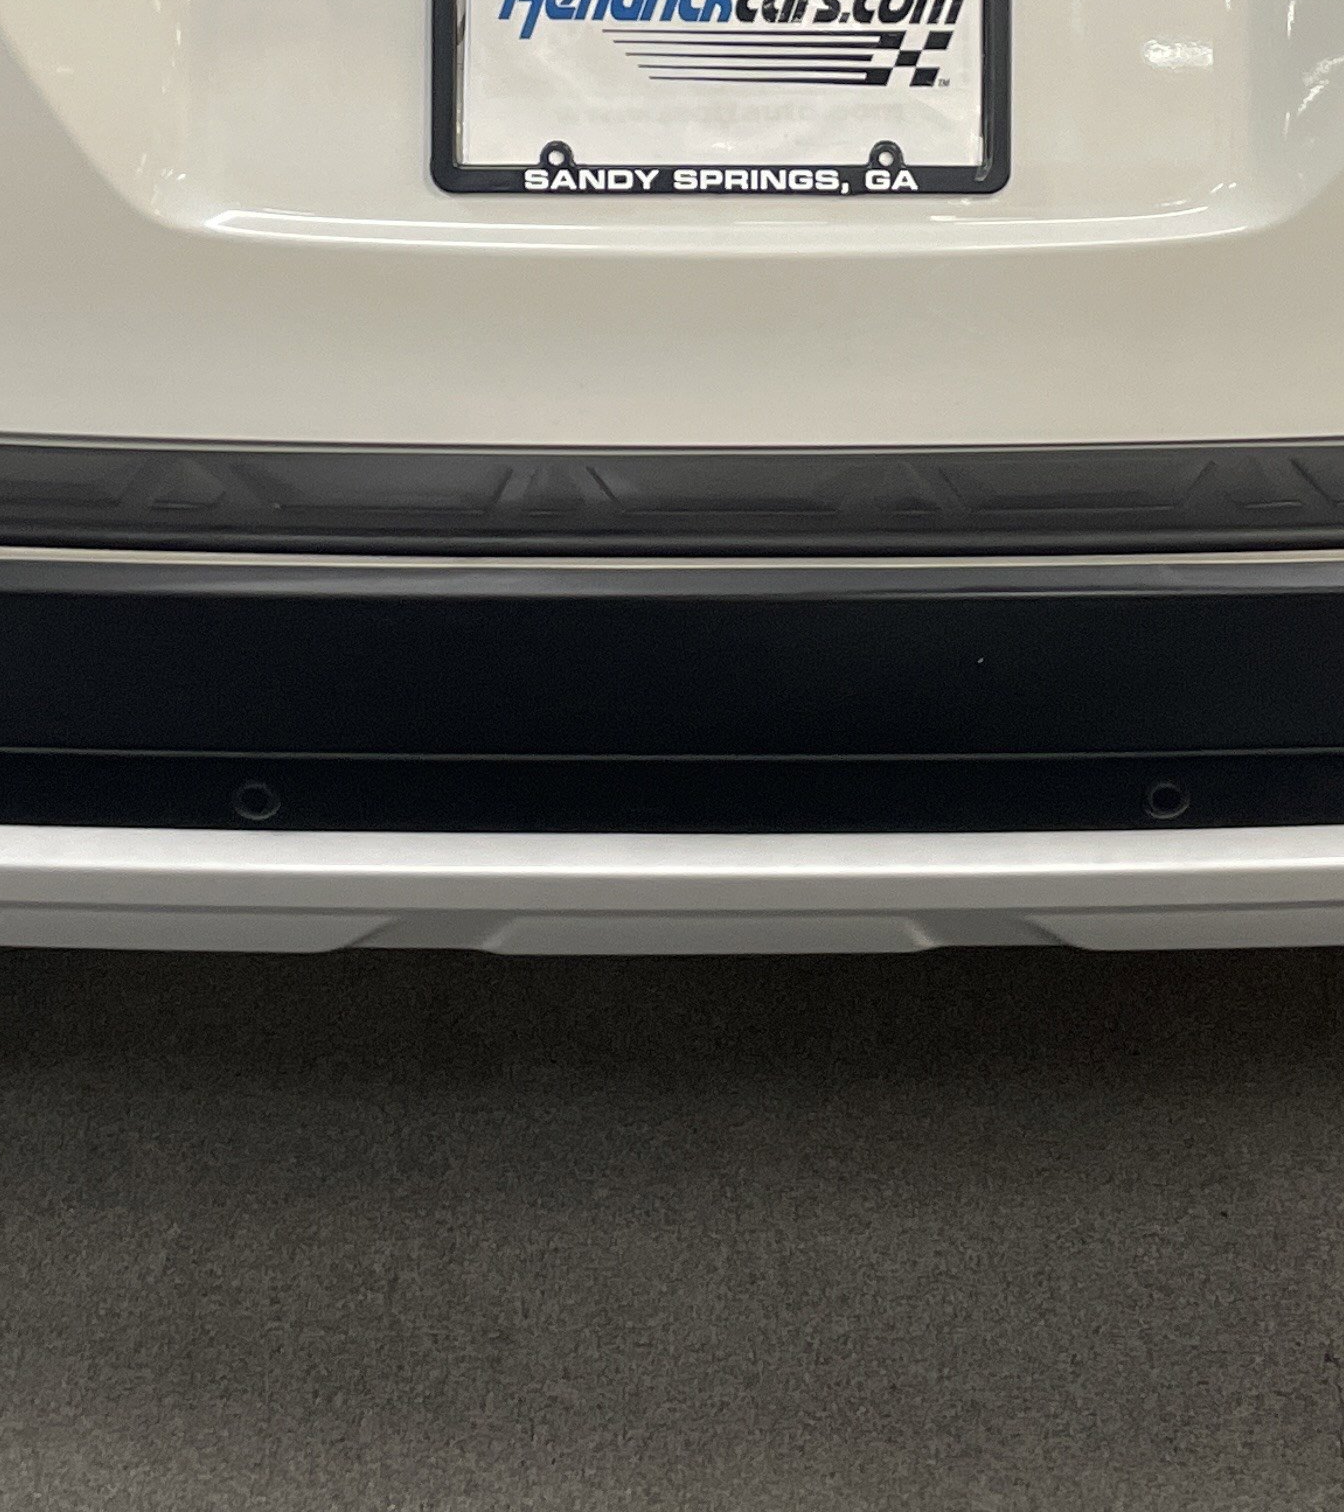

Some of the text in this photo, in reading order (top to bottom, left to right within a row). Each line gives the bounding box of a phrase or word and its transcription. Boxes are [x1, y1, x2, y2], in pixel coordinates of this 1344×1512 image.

[523, 169, 919, 194] SANDY SPRINGS, GA
